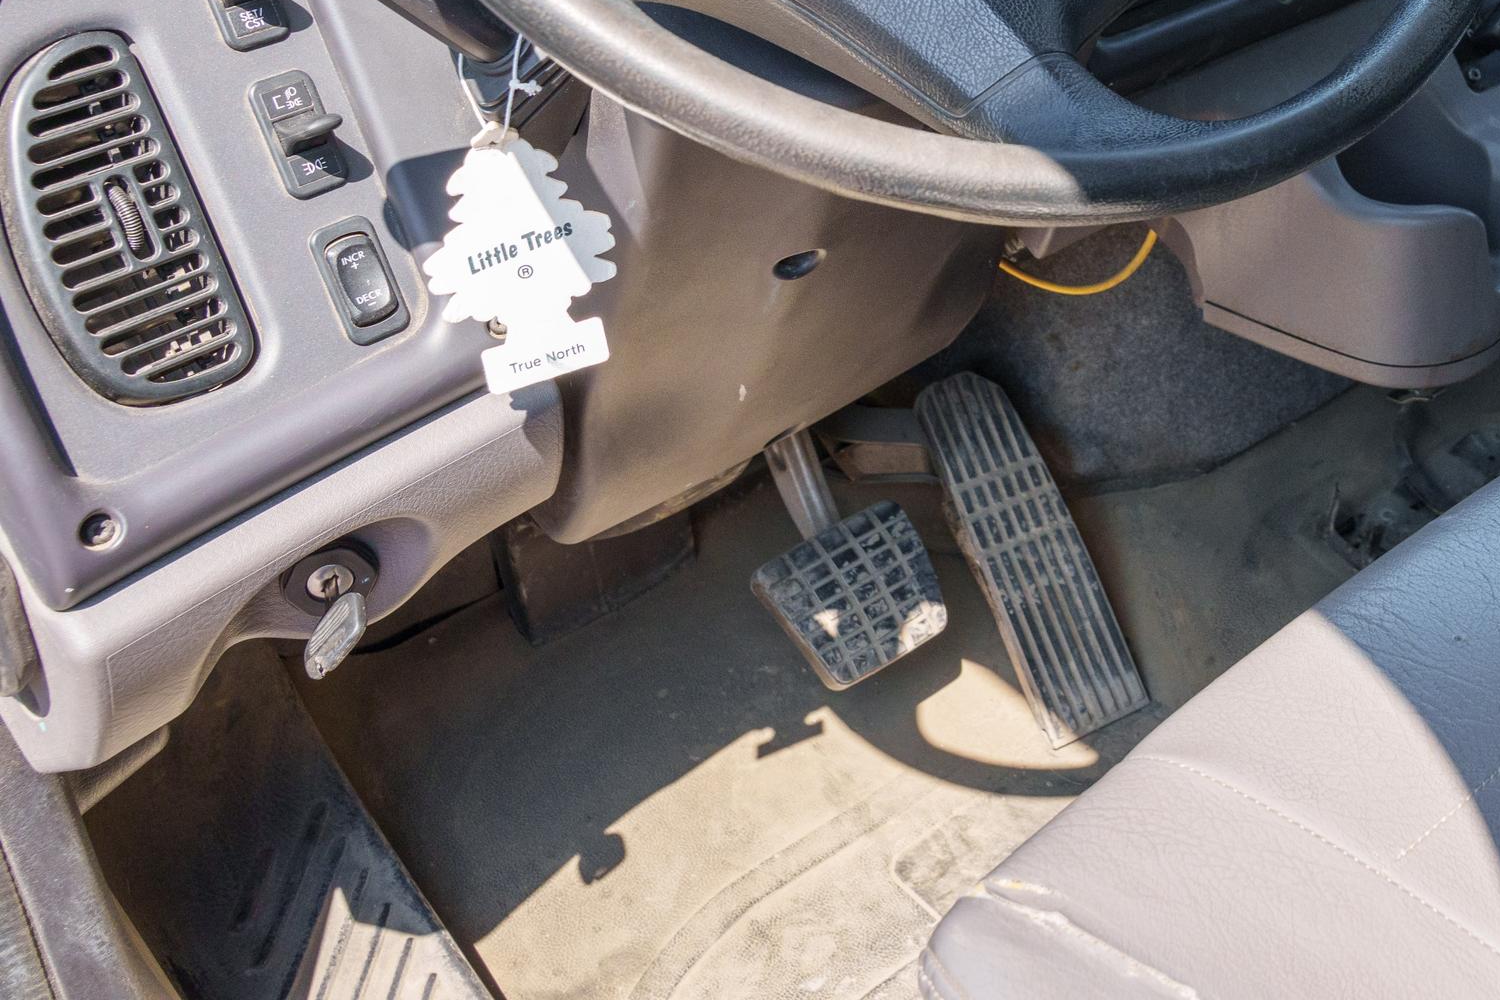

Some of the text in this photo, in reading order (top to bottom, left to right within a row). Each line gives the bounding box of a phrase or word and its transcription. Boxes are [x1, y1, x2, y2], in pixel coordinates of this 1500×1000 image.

[245, 17, 265, 29] CST
[468, 222, 573, 275] Little Trees
[341, 250, 365, 266] INCR
[355, 288, 383, 305] DECR
[509, 343, 586, 374] True North
